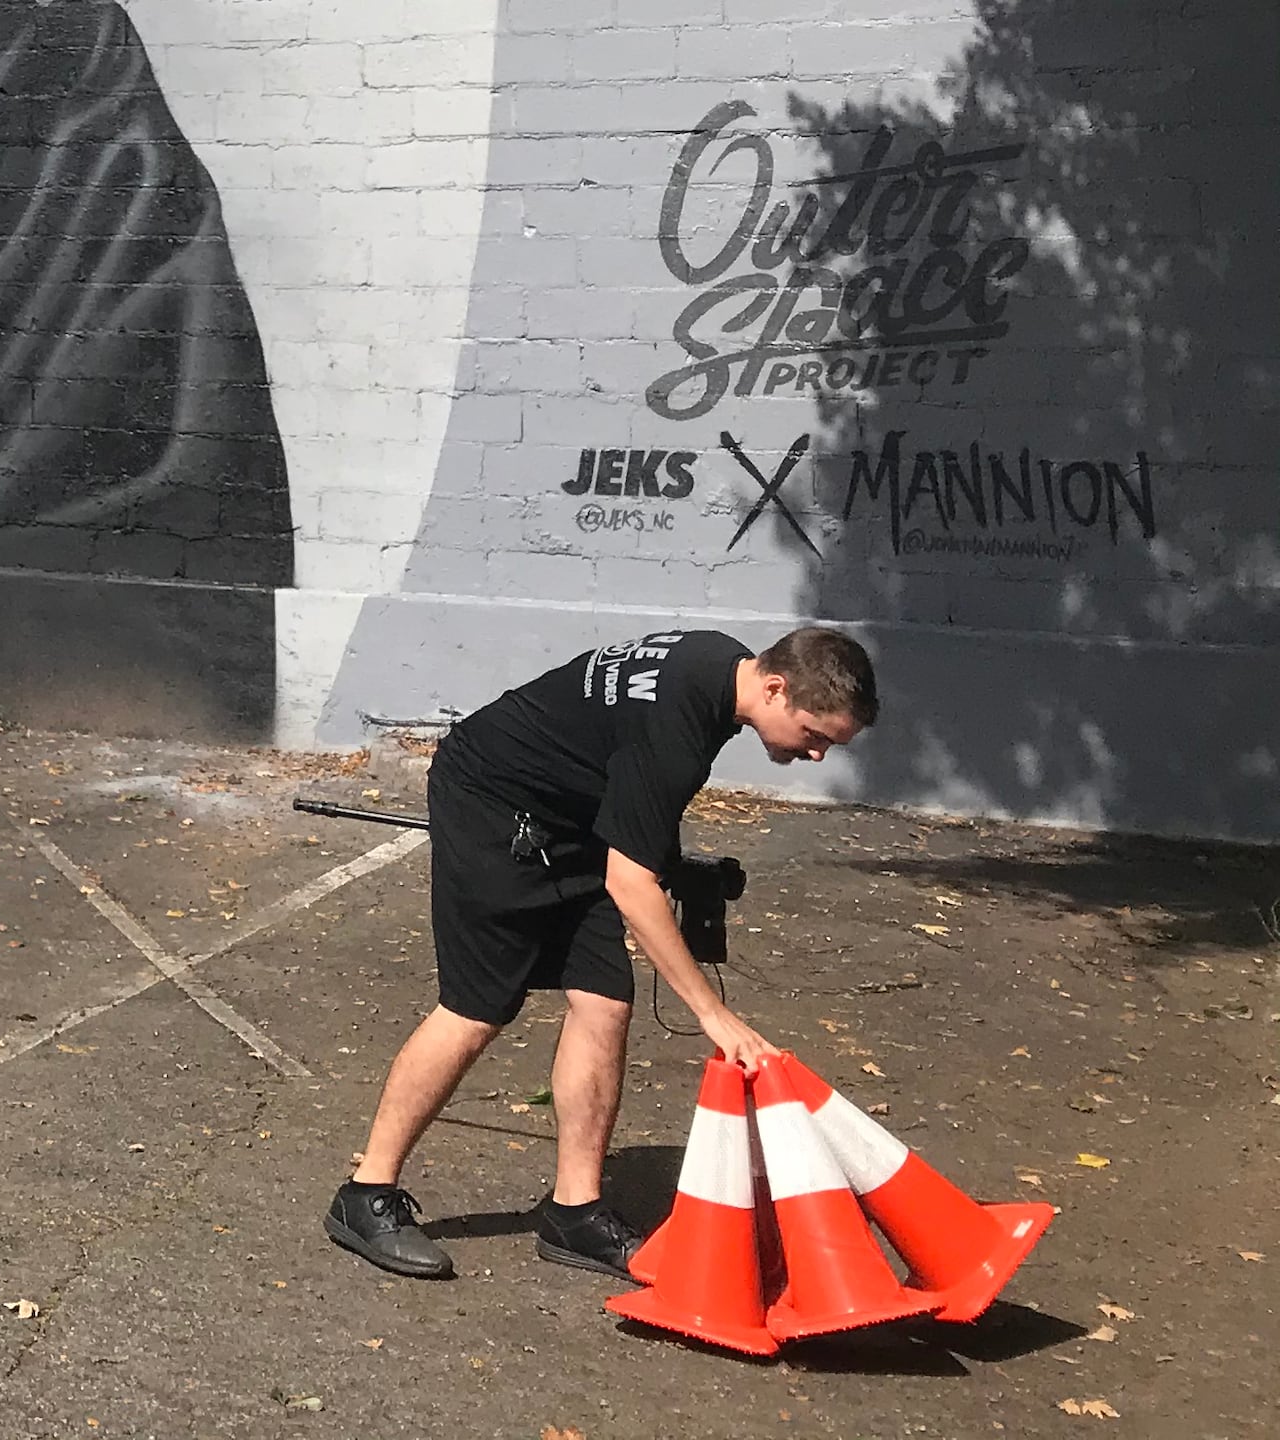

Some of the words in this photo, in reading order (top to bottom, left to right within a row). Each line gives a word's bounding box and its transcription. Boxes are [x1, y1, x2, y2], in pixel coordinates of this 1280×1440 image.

[659, 100, 1027, 284] Outer
[646, 240, 1029, 420] Space
[764, 348, 990, 394] PROJECT
[561, 448, 698, 498] JEKS
[843, 430, 1155, 556] MANNION
[576, 503, 675, 533] @JEKS_NC
[605, 662, 621, 706] VIDEO
